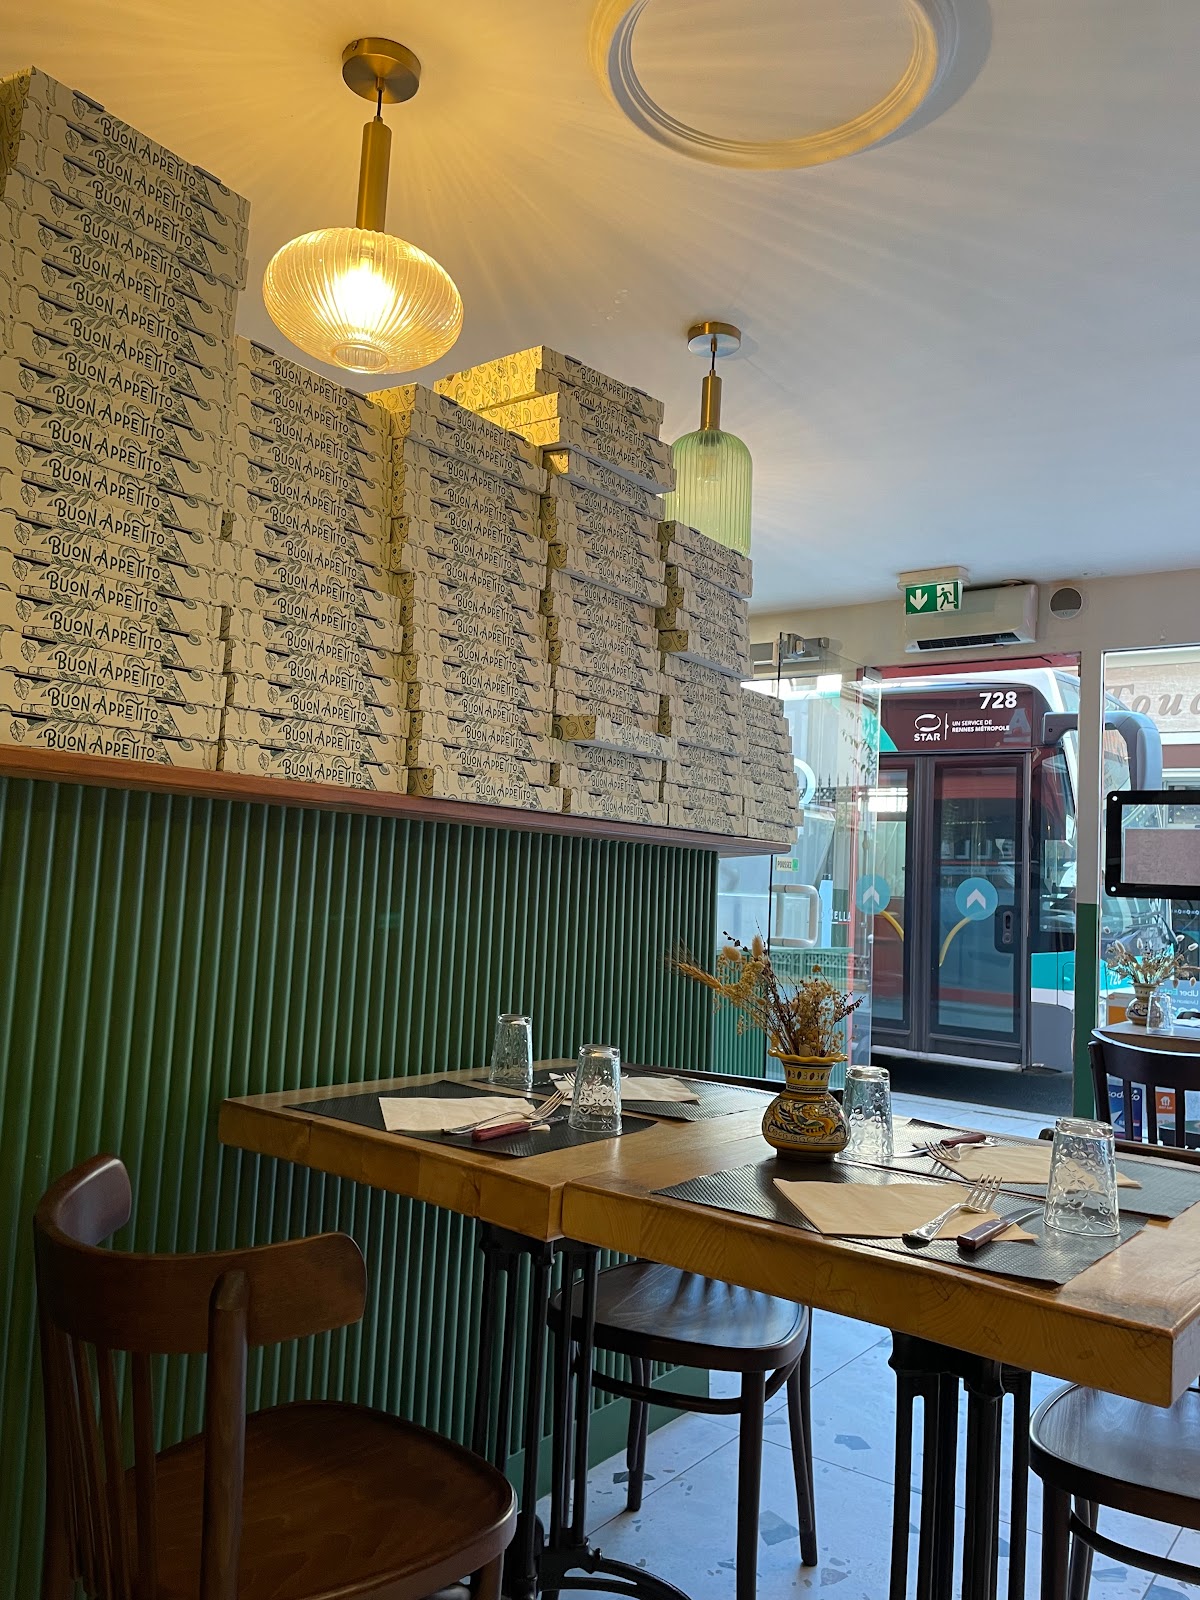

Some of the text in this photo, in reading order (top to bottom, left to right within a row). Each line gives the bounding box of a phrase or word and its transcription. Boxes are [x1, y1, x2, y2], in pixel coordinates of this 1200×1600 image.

[100, 118, 137, 152] BUON
[94, 150, 132, 184] BUON
[92, 180, 131, 214] BUON
[80, 214, 119, 247] BUON
[69, 246, 110, 278] BUON
[73, 281, 114, 313] BUON
[70, 317, 111, 349] BUON
[65, 352, 107, 382] BUON
[273, 360, 302, 384] BUON
[53, 385, 96, 415] BUON
[273, 388, 302, 412] BUON
[49, 420, 92, 449] BUON
[274, 418, 303, 442] BUON
[272, 447, 302, 470] BUON
[49, 458, 92, 487] BUON
[270, 477, 300, 500] BUON
[54, 498, 97, 526] BUON
[270, 506, 300, 529] BUON
[49, 535, 92, 562] BUON
[285, 541, 313, 563] BUON
[48, 570, 90, 596] BUON
[278, 567, 308, 588] BUON
[278, 598, 308, 619] BUON
[50, 611, 94, 636] BUON
[285, 631, 314, 651] BUON
[54, 650, 97, 674] BUON
[288, 661, 317, 681] BUON
[49, 687, 91, 710] BUON
[291, 694, 320, 713] BUON
[980, 691, 1017, 709] 728
[44, 728, 87, 751] BUON
[283, 725, 313, 743] BUON
[914, 733, 940, 742] STAR
[282, 759, 313, 777] BUON
